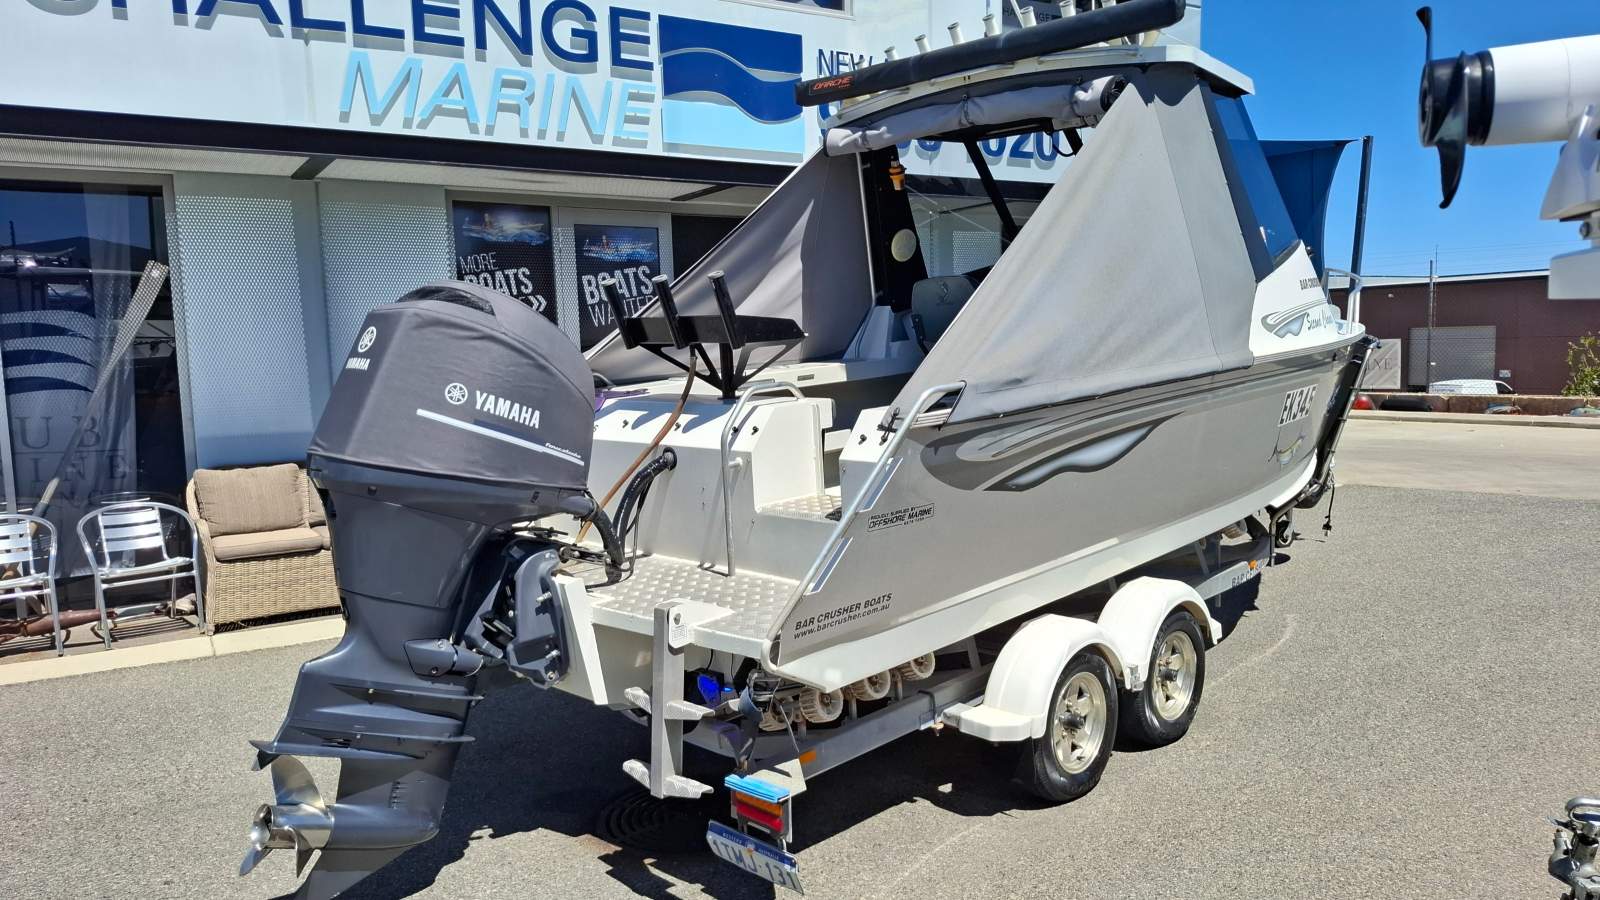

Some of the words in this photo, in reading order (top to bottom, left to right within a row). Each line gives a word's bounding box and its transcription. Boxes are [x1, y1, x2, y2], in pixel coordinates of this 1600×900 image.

[339, 51, 656, 141] MARINE
[460, 252, 498, 273] MORE
[475, 390, 540, 428] YAMAHA
[868, 513, 907, 529] OFFSHORE
[907, 507, 932, 520] MARINE
[793, 603, 890, 639] www.barcrusher.com.au
[795, 617, 815, 630] BAR
[817, 603, 861, 623] CRUSHER
[864, 593, 893, 608] BOATS
